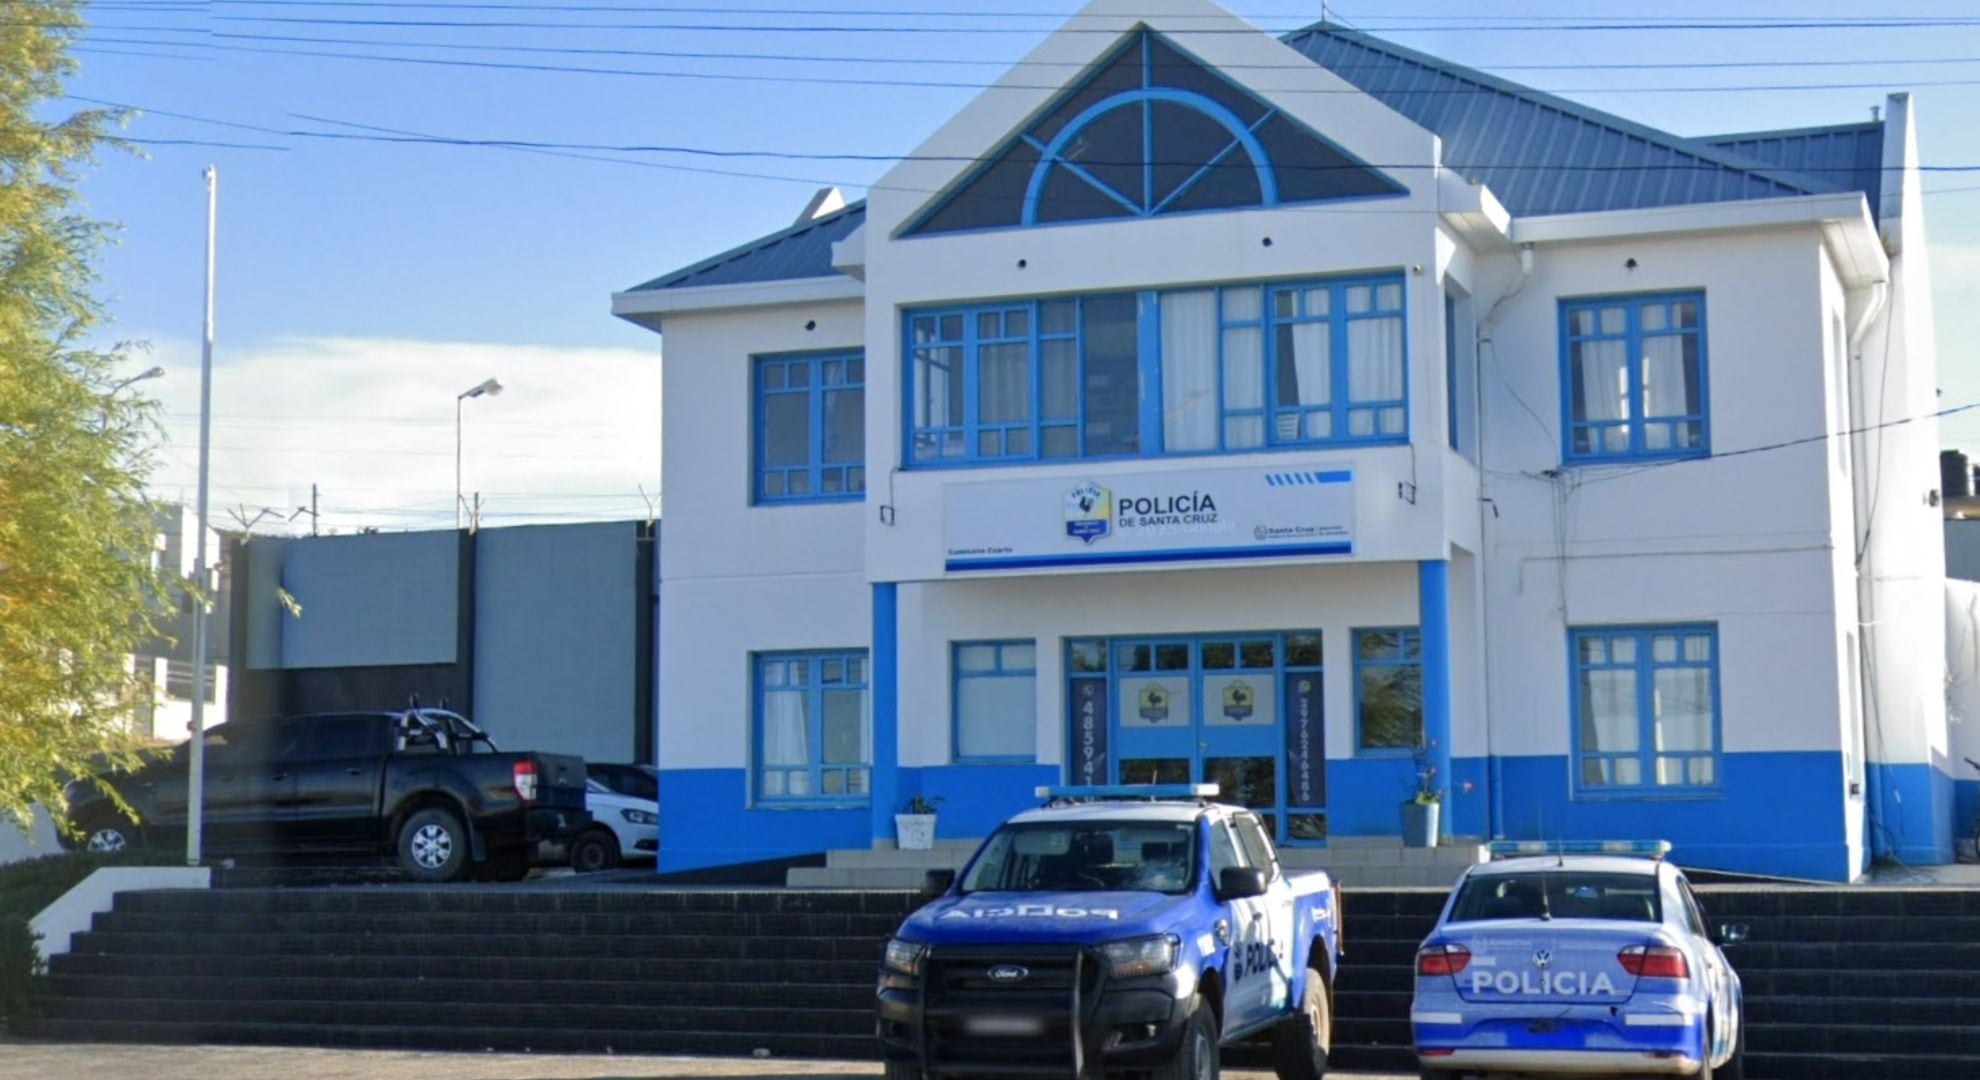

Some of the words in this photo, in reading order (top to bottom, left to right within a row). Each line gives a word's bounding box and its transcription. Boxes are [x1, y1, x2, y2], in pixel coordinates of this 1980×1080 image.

[1119, 491, 1217, 516] POLICÍA
[1119, 517, 1136, 528] DE
[1138, 515, 1181, 527] SANTA
[1183, 513, 1218, 524] CRUZ
[1472, 971, 1615, 994] POLICIA
